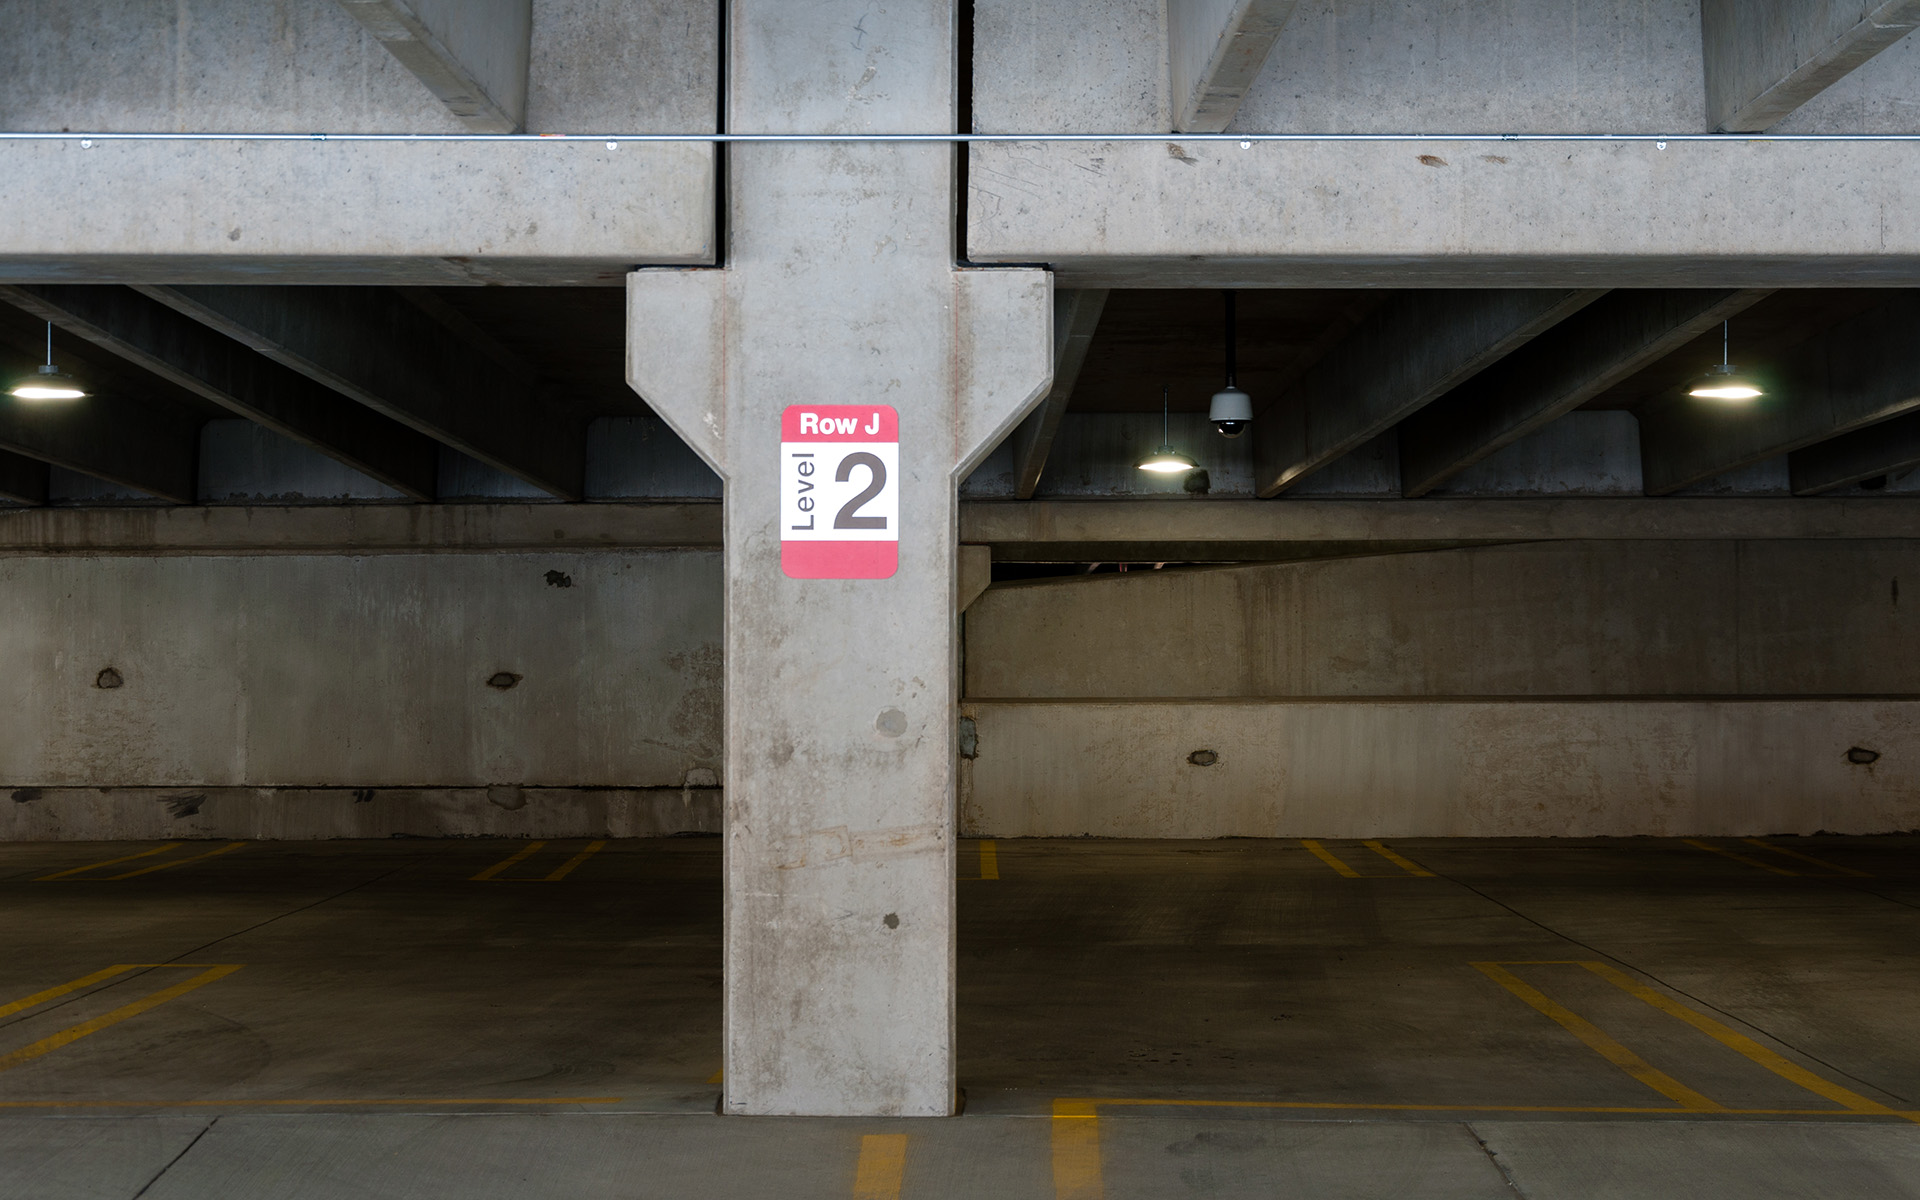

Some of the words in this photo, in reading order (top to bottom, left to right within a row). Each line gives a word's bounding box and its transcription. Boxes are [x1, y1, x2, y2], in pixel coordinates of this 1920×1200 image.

[800, 412, 858, 435] Row
[864, 412, 880, 435] J
[791, 453, 815, 531] Level
[833, 451, 888, 530] 2
